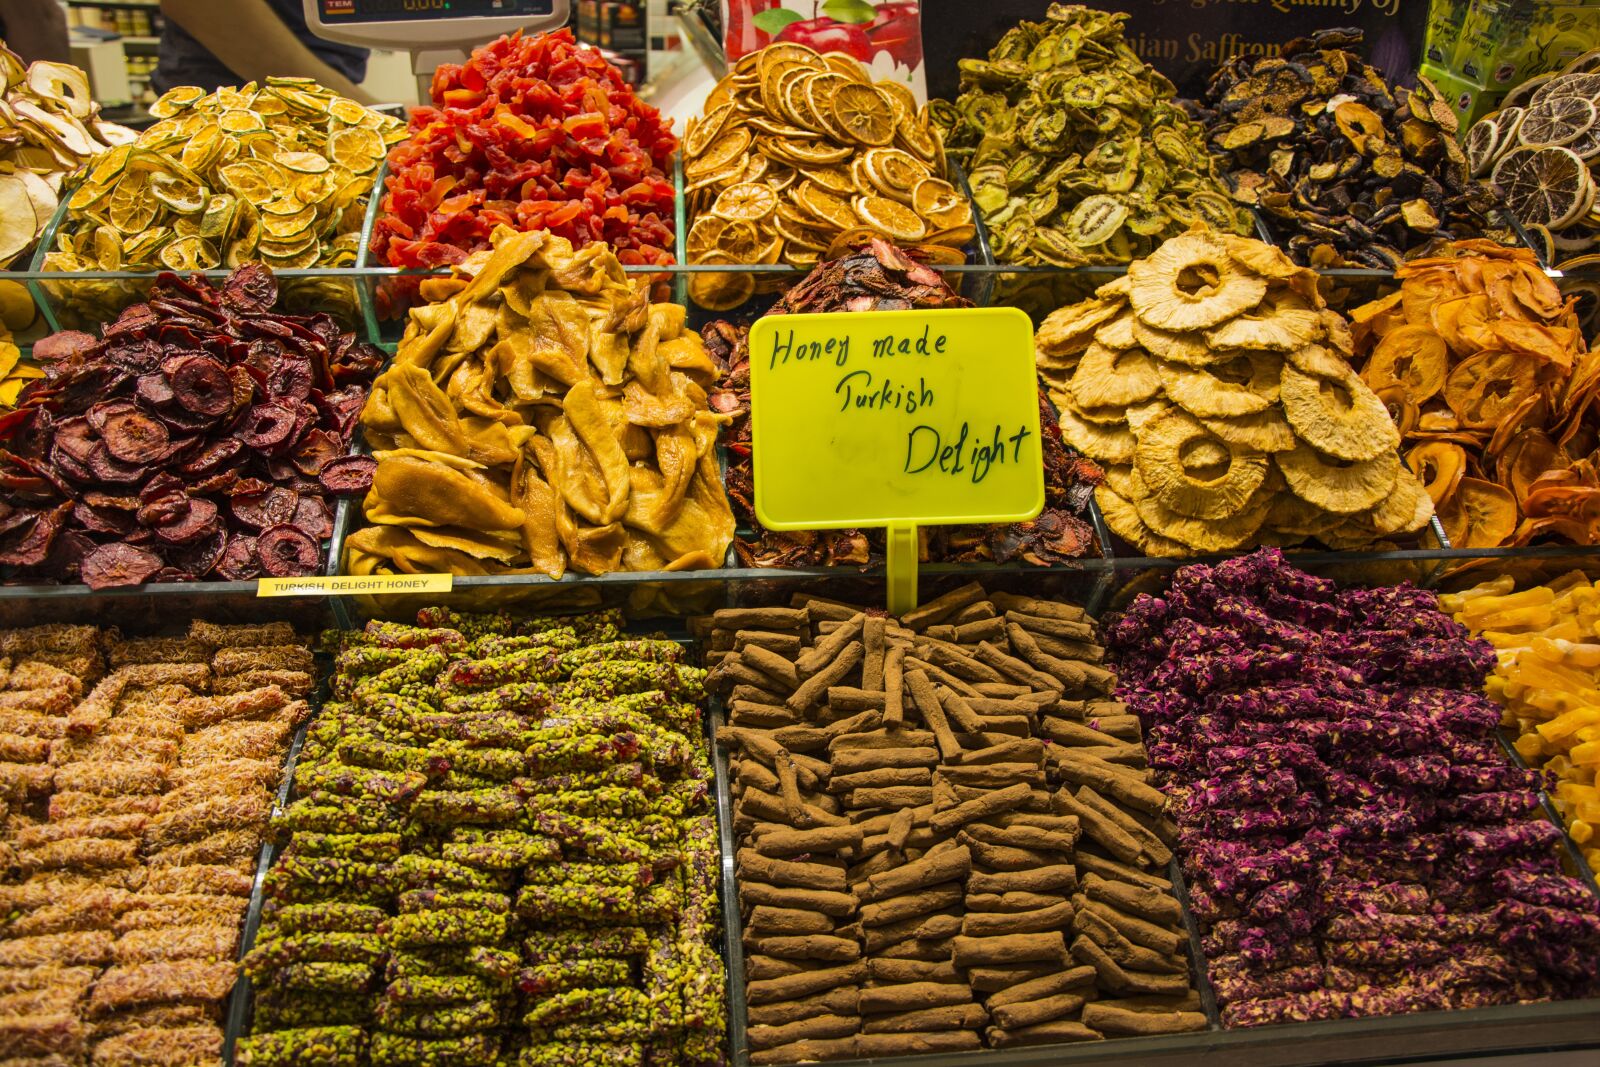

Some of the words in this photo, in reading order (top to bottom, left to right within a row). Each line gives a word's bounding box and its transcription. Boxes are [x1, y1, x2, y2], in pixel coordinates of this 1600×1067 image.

[1185, 33, 1282, 66] Saffron
[770, 329, 850, 370] Honey
[873, 324, 947, 358] made
[835, 370, 934, 413] Turkish
[904, 421, 1031, 484] Delight
[274, 582, 325, 592] TURKISH
[331, 580, 384, 590] DELIGHT
[387, 579, 429, 589] HONEY
